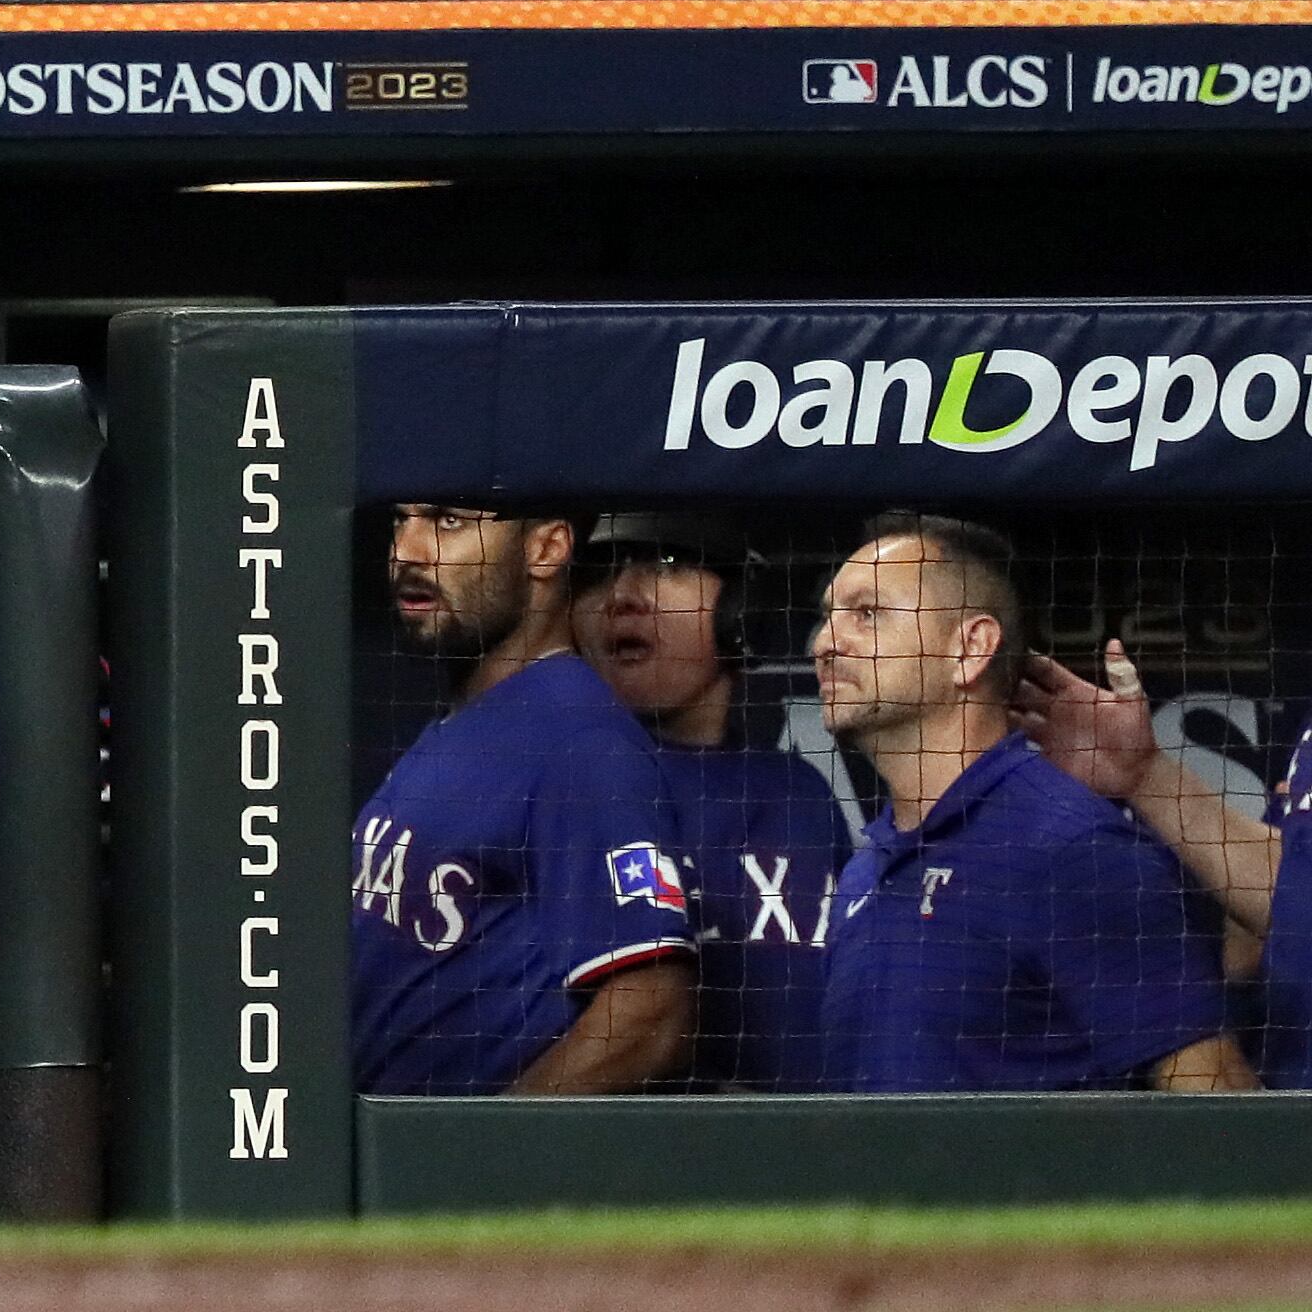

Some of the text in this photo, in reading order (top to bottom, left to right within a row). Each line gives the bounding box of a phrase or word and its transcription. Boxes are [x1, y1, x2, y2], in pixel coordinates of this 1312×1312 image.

[346, 72, 468, 99] 2023
[887, 55, 1048, 108] ALCS
[664, 338, 1312, 471] loanDepo
[922, 867, 953, 919] T
